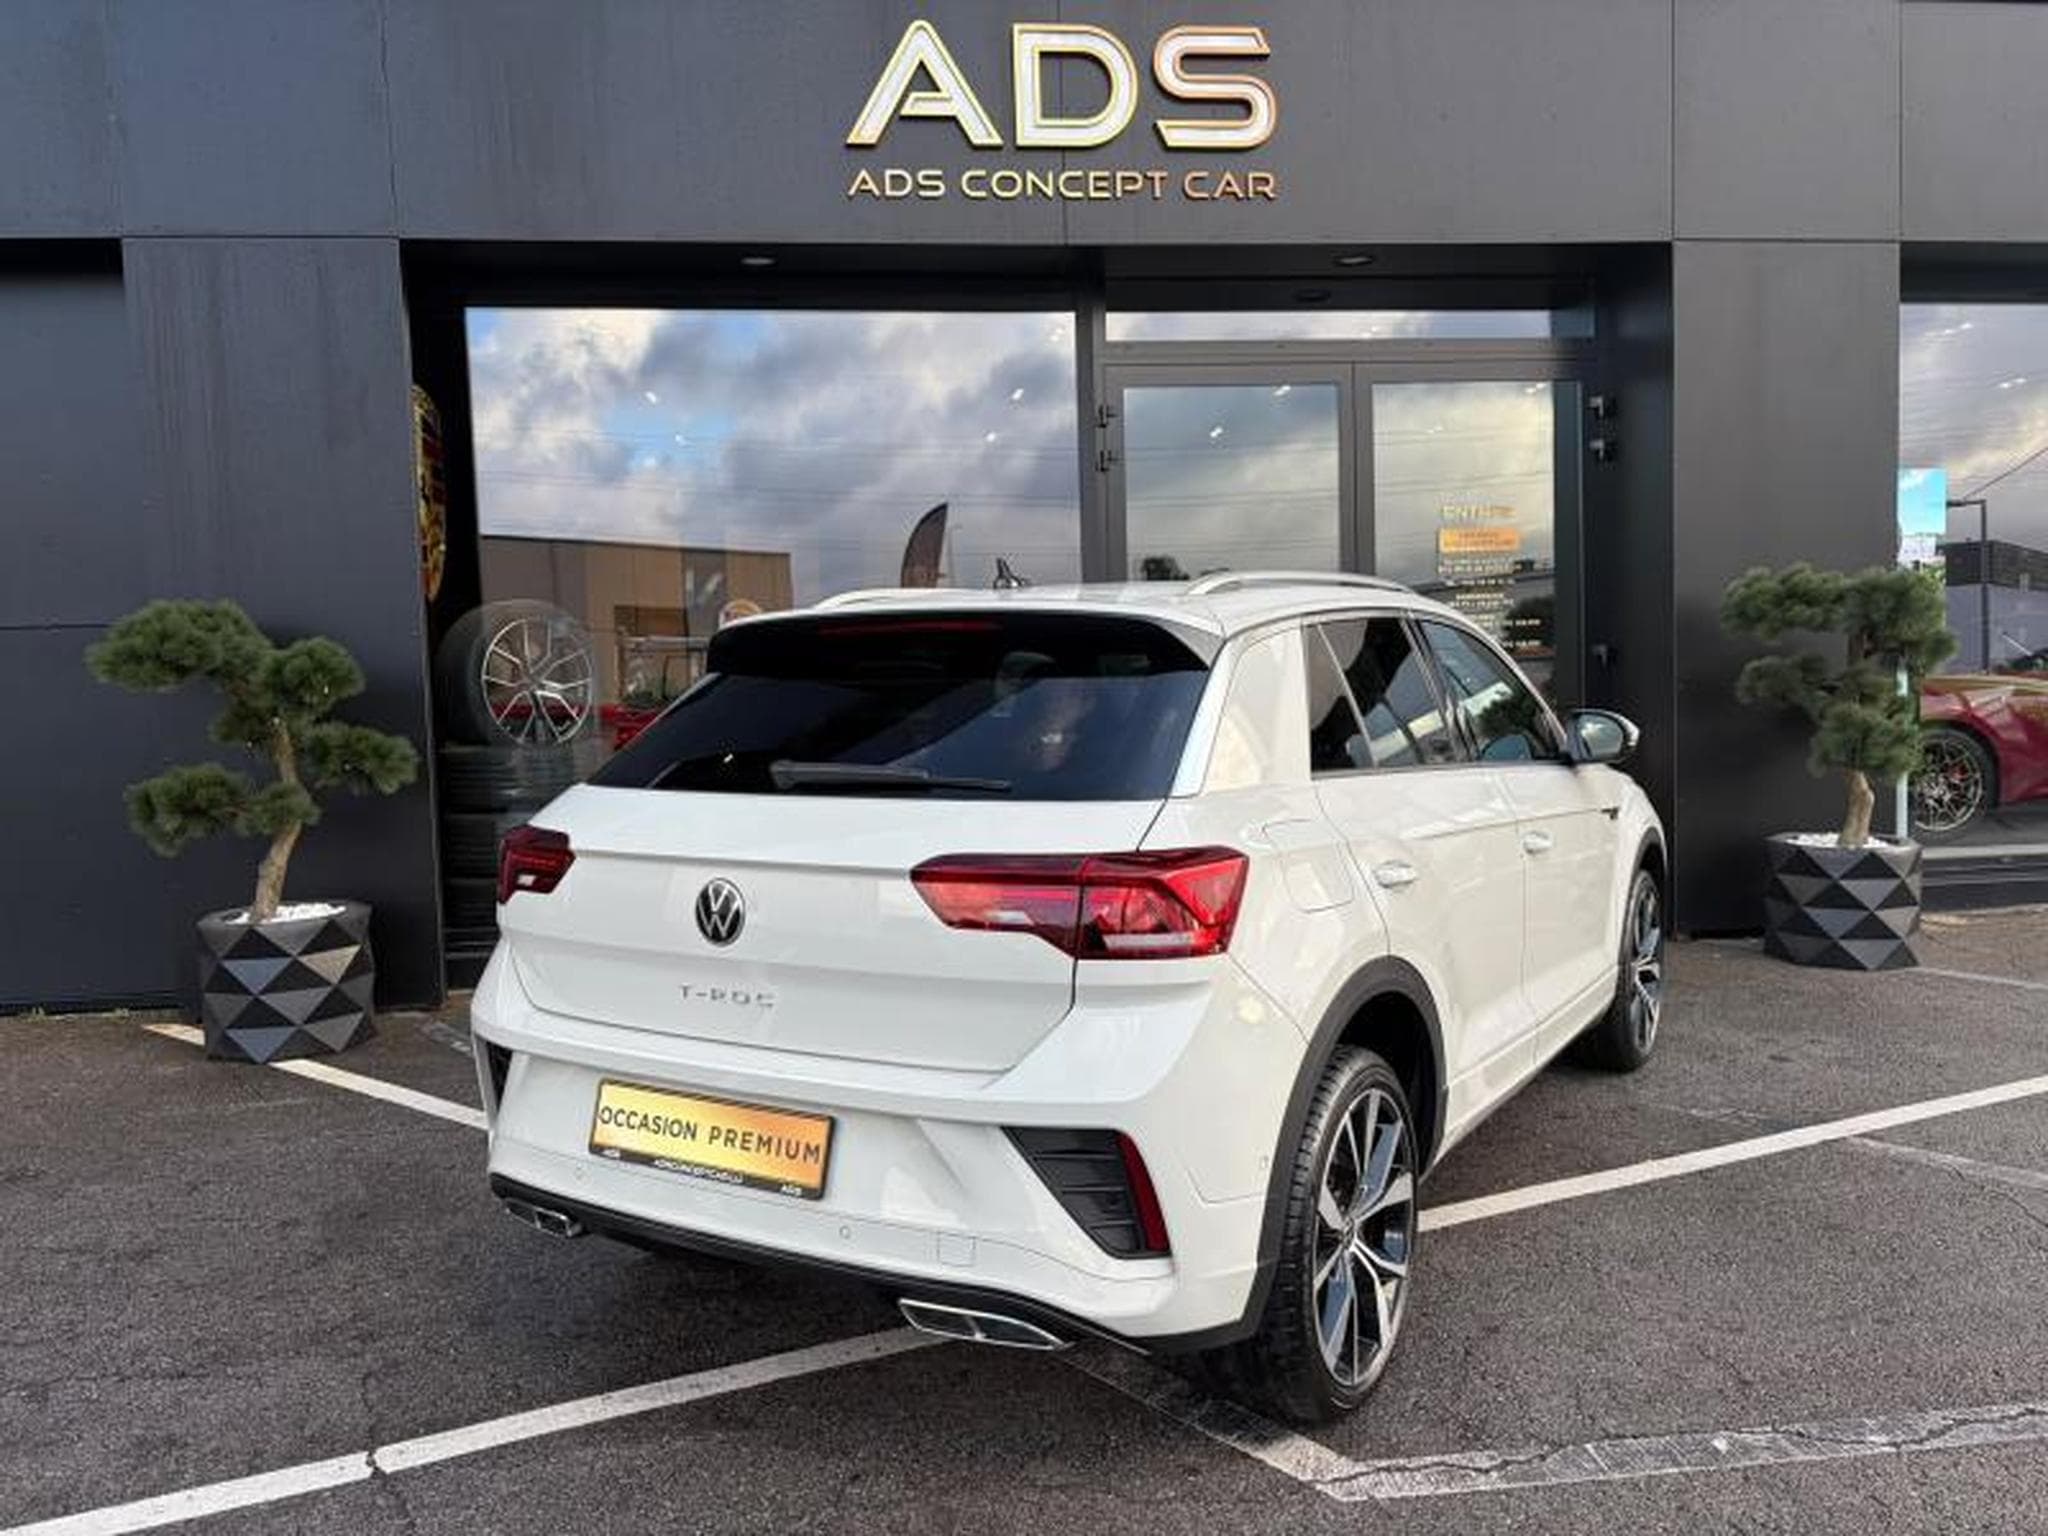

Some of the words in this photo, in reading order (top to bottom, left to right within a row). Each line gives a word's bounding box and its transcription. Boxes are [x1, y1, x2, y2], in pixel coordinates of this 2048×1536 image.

[845, 19, 1277, 149] ADS
[847, 167, 946, 198] ADS
[959, 168, 1169, 199] CONCEPT
[1183, 171, 1277, 200] CAR
[599, 1105, 698, 1141] OCCASION
[707, 1125, 821, 1165] PREMIUM
